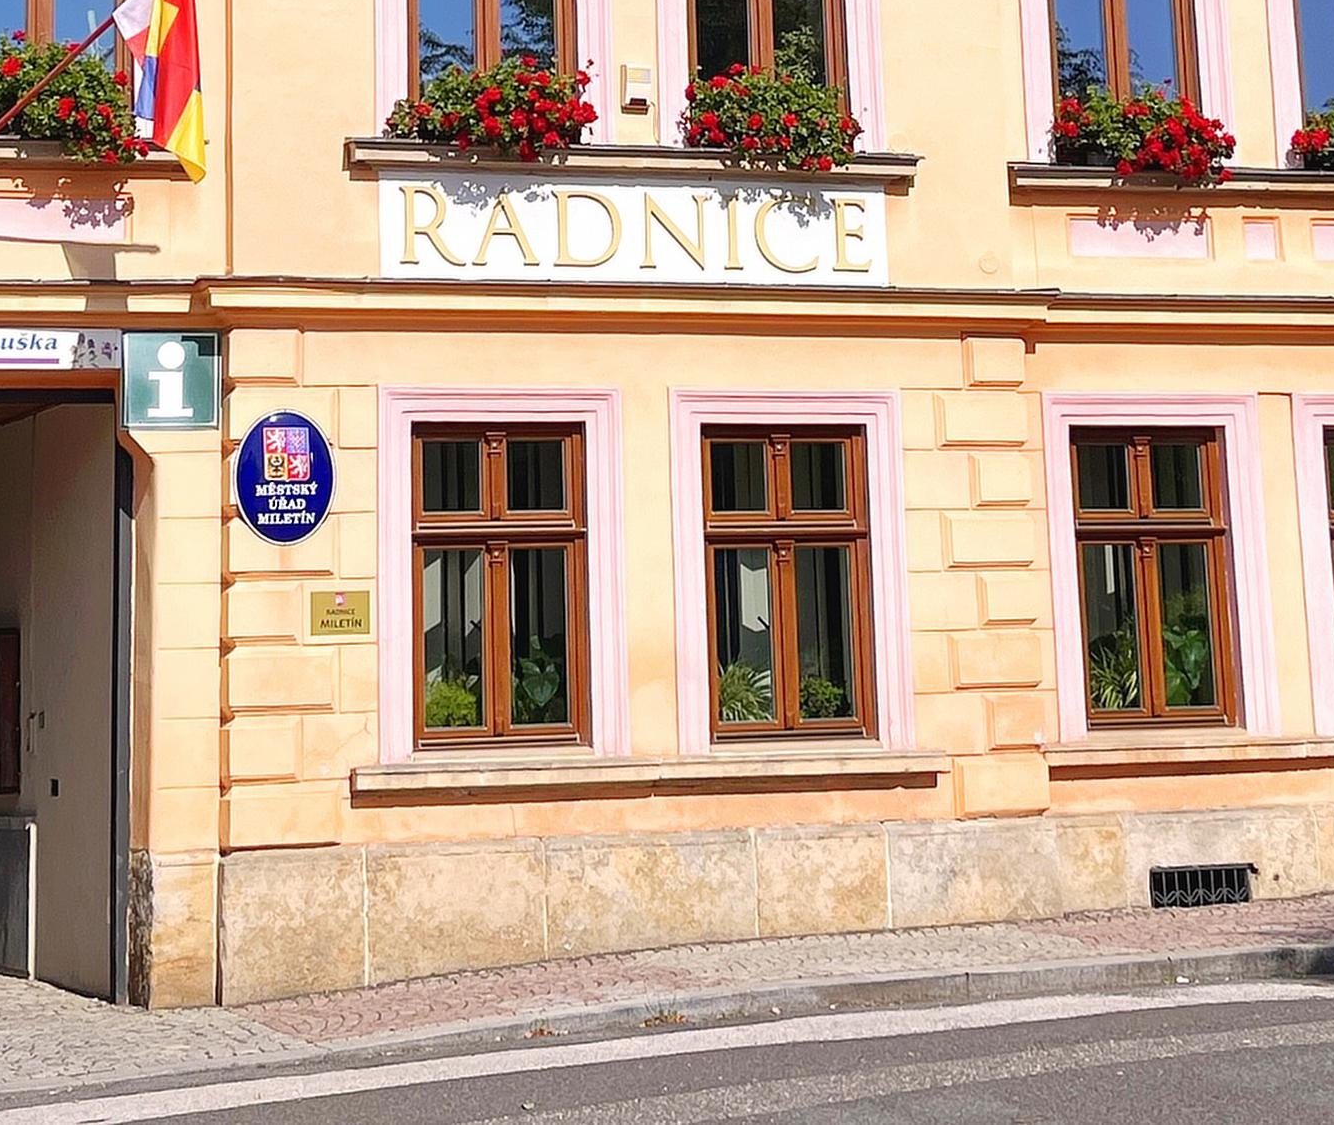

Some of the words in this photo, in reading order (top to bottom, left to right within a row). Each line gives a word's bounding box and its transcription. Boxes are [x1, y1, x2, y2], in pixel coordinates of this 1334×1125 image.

[399, 185, 873, 273] RADNICE
[255, 481, 318, 496] MĚSTSKÝ
[268, 496, 307, 510] ÚŘAD
[257, 510, 316, 524] MILETÍN
[320, 617, 362, 628] MILETÍN
